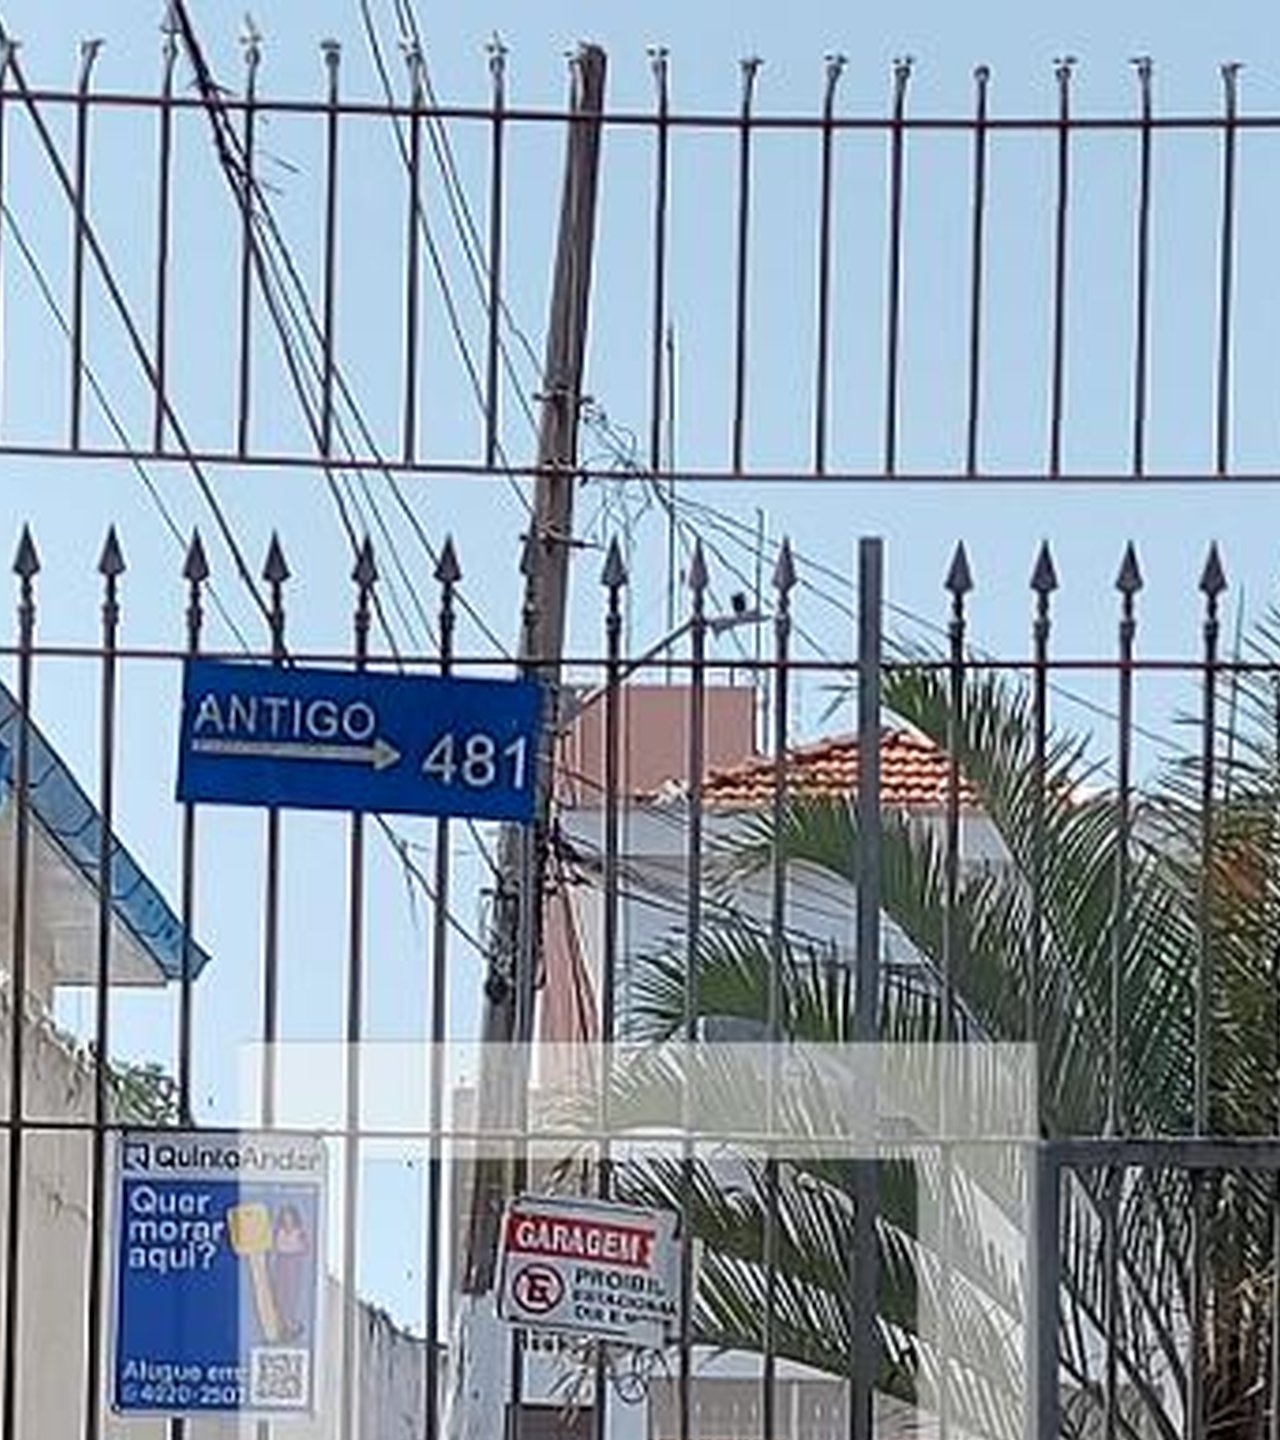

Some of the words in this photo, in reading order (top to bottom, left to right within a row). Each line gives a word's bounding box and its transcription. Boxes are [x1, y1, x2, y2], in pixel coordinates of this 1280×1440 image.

[193, 694, 375, 739] ANTIGO
[422, 734, 526, 789] 481
[130, 1185, 211, 1215] Quer
[129, 1220, 225, 1242] morar
[128, 1240, 217, 1274] aqui?
